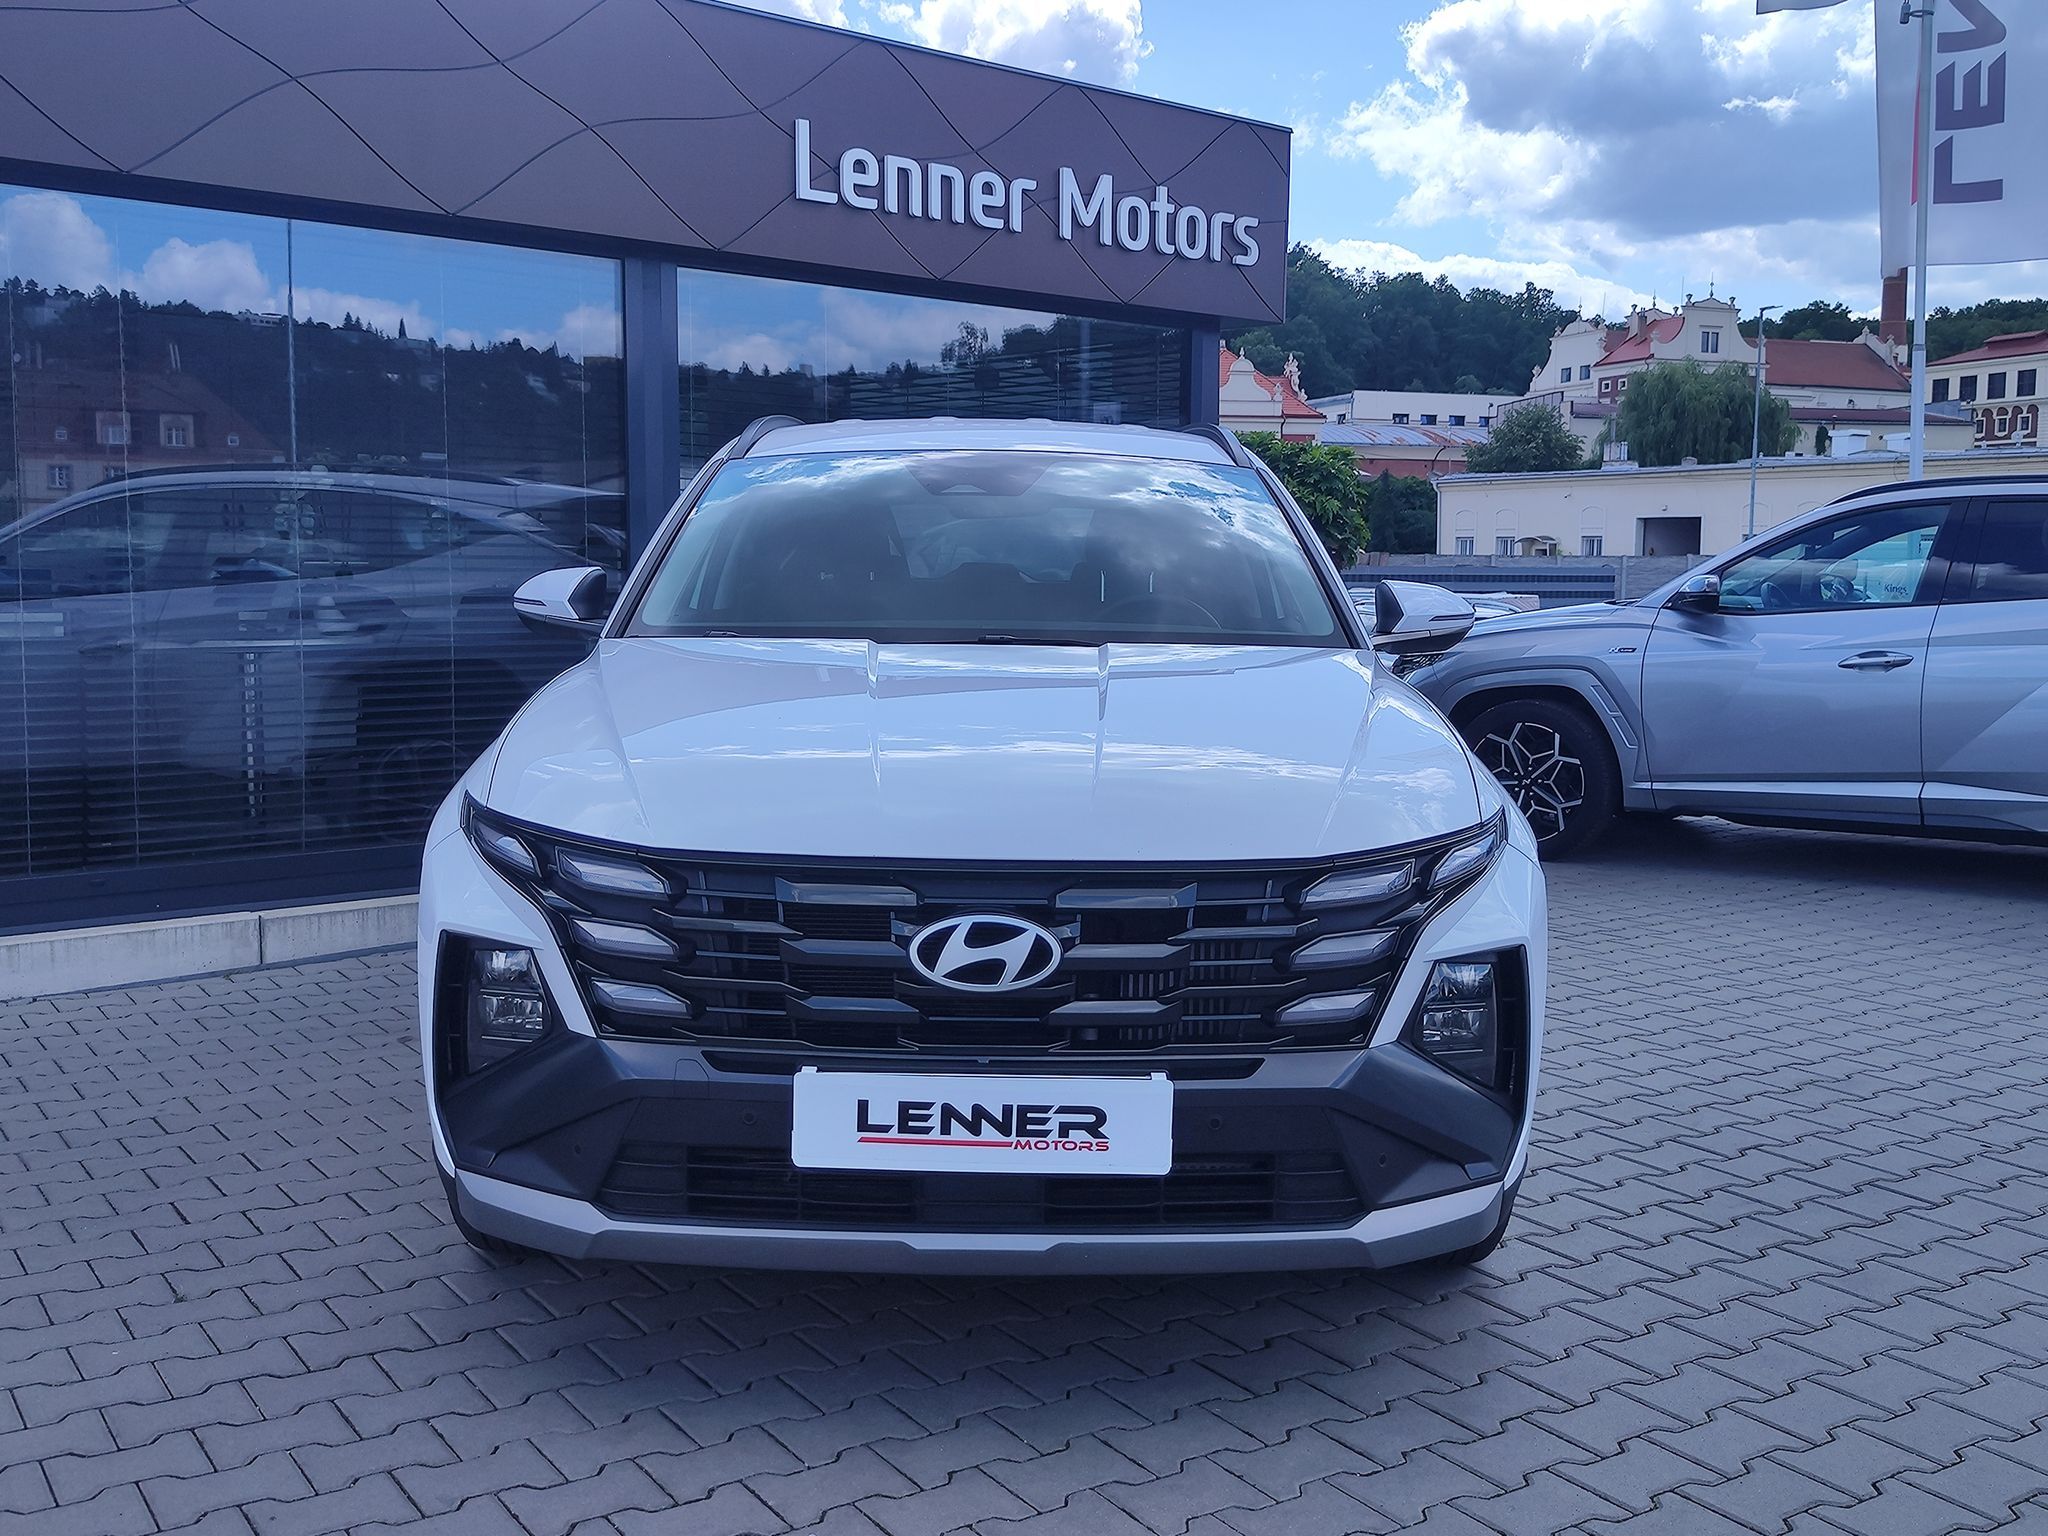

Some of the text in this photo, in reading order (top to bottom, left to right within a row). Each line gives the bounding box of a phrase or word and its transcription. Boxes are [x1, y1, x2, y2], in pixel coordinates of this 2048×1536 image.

[794, 118, 1260, 266] Lenner Motors
[857, 1098, 1110, 1139] LENNER
[1013, 1139, 1110, 1152] MOTORS
